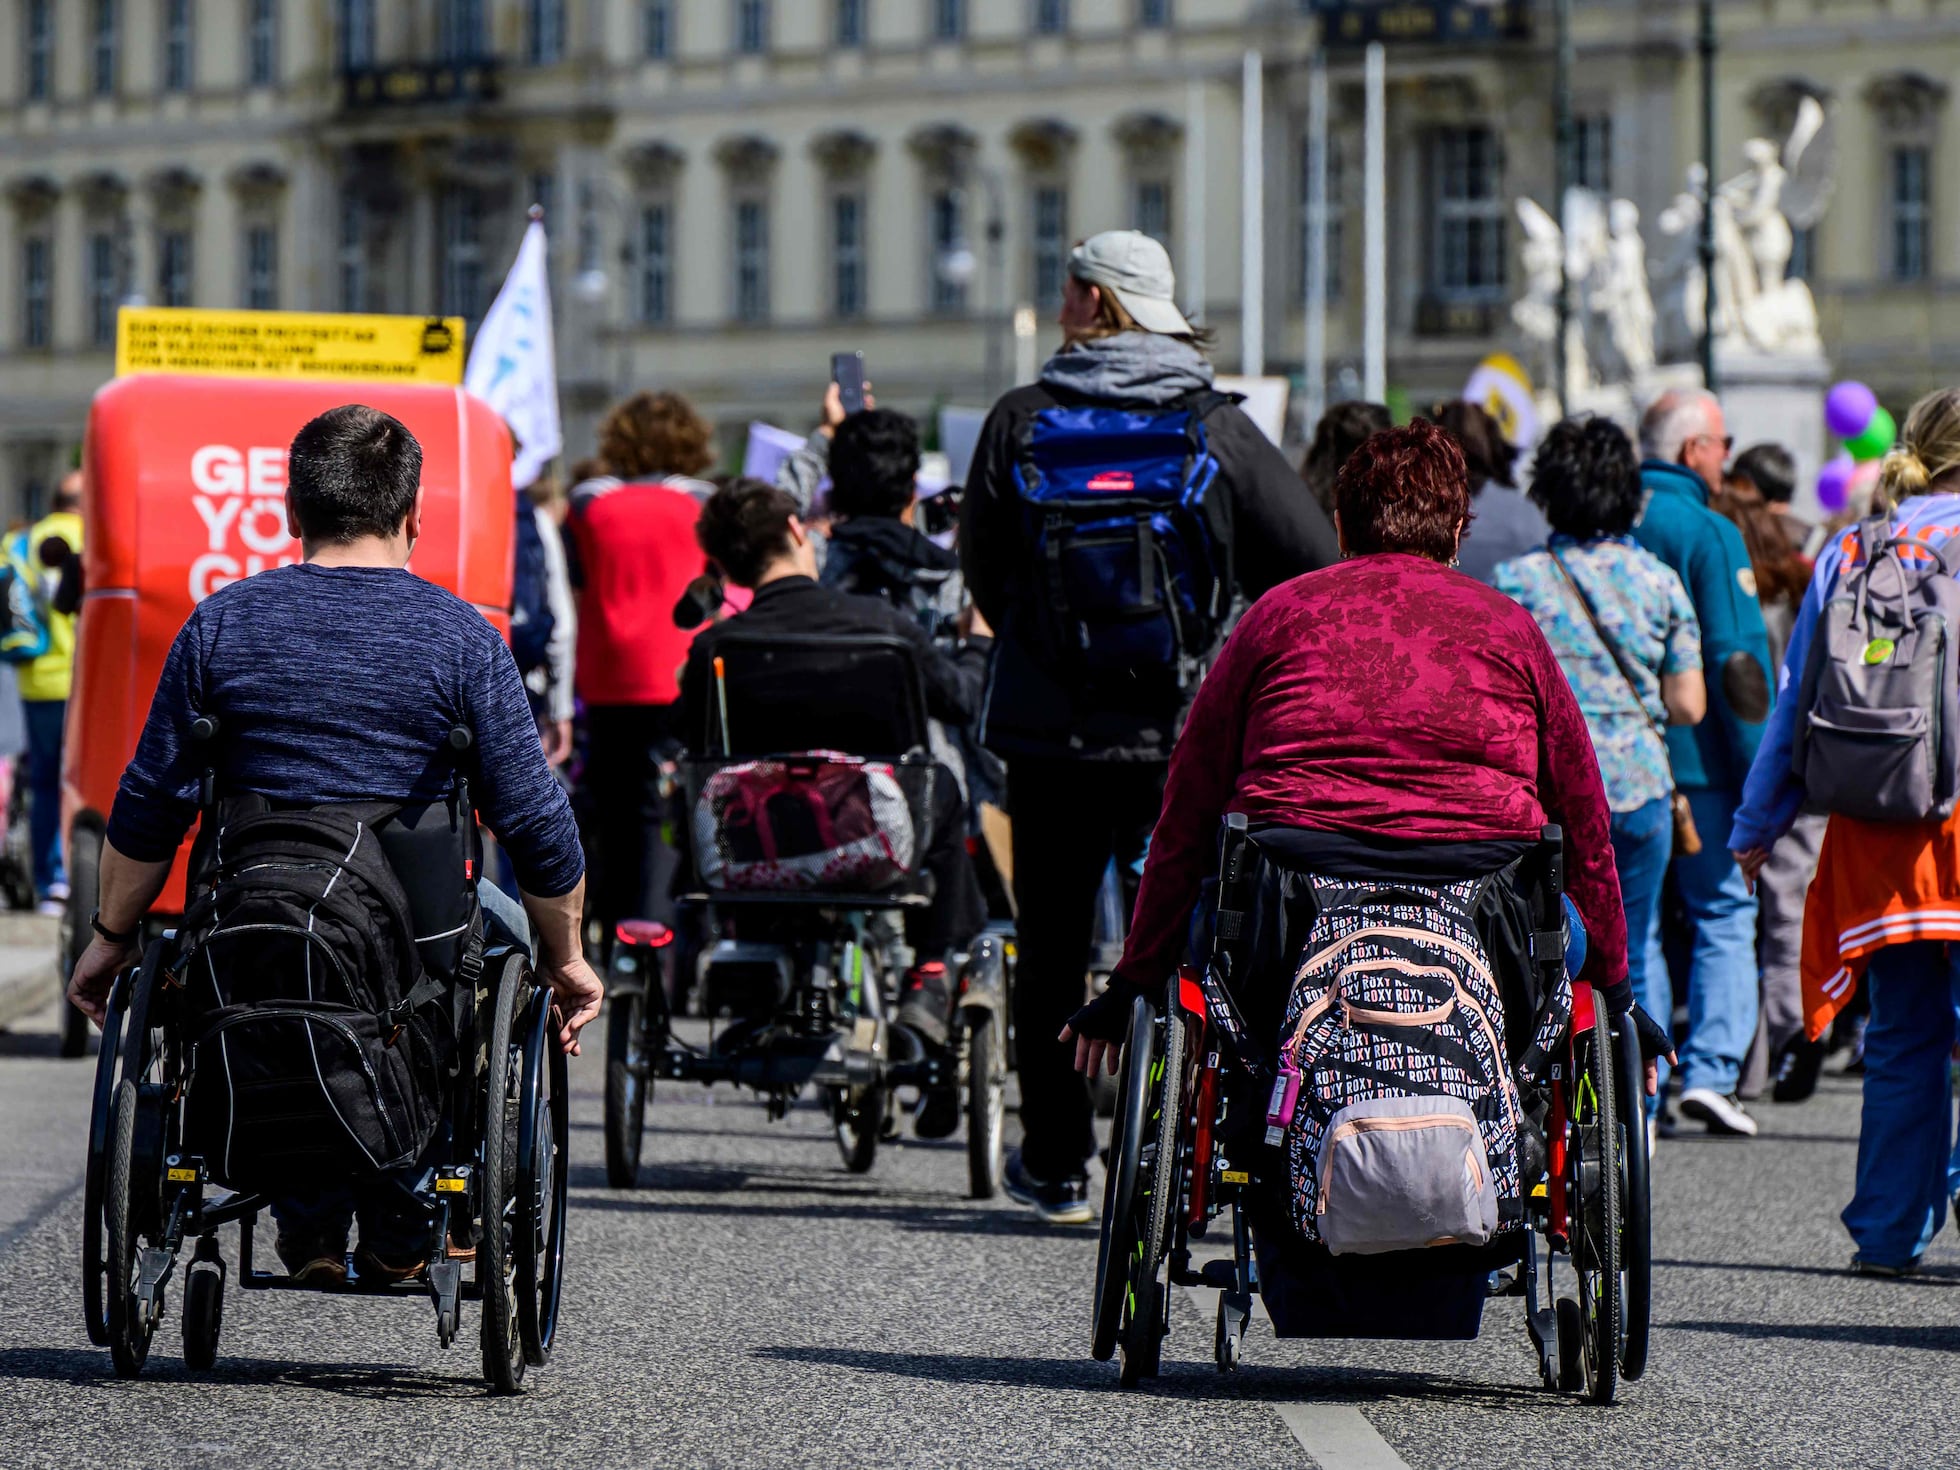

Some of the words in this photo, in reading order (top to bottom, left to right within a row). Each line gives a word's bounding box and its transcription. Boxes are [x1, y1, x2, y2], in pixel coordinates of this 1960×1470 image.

[191, 445, 288, 496] GE
[1426, 912, 1451, 926] ROXY
[1426, 920, 1451, 935] ROXY
[1455, 929, 1478, 949] ROXY
[1351, 944, 1378, 959] ROXY
[1362, 977, 1390, 990] ROXY
[1466, 977, 1488, 999] ROXY
[1364, 989, 1392, 1002] ROXY
[1396, 989, 1423, 1002] ROXY
[1303, 1038, 1321, 1069] ROXY
[1313, 1016, 1337, 1043] ROXY
[1344, 1047, 1371, 1062] ROXY
[1374, 1042, 1402, 1058] ROXY
[1376, 1056, 1404, 1071] ROXY
[1408, 1055, 1435, 1068] ROXY
[1315, 1070, 1340, 1085] ROXY
[1409, 1067, 1437, 1082] ROXY
[1441, 1067, 1465, 1081] ROXY
[1317, 1082, 1342, 1099] ROXY
[1346, 1078, 1372, 1094] ROXY
[1377, 1087, 1406, 1099] ROXY
[1442, 1082, 1467, 1098] ROXY
